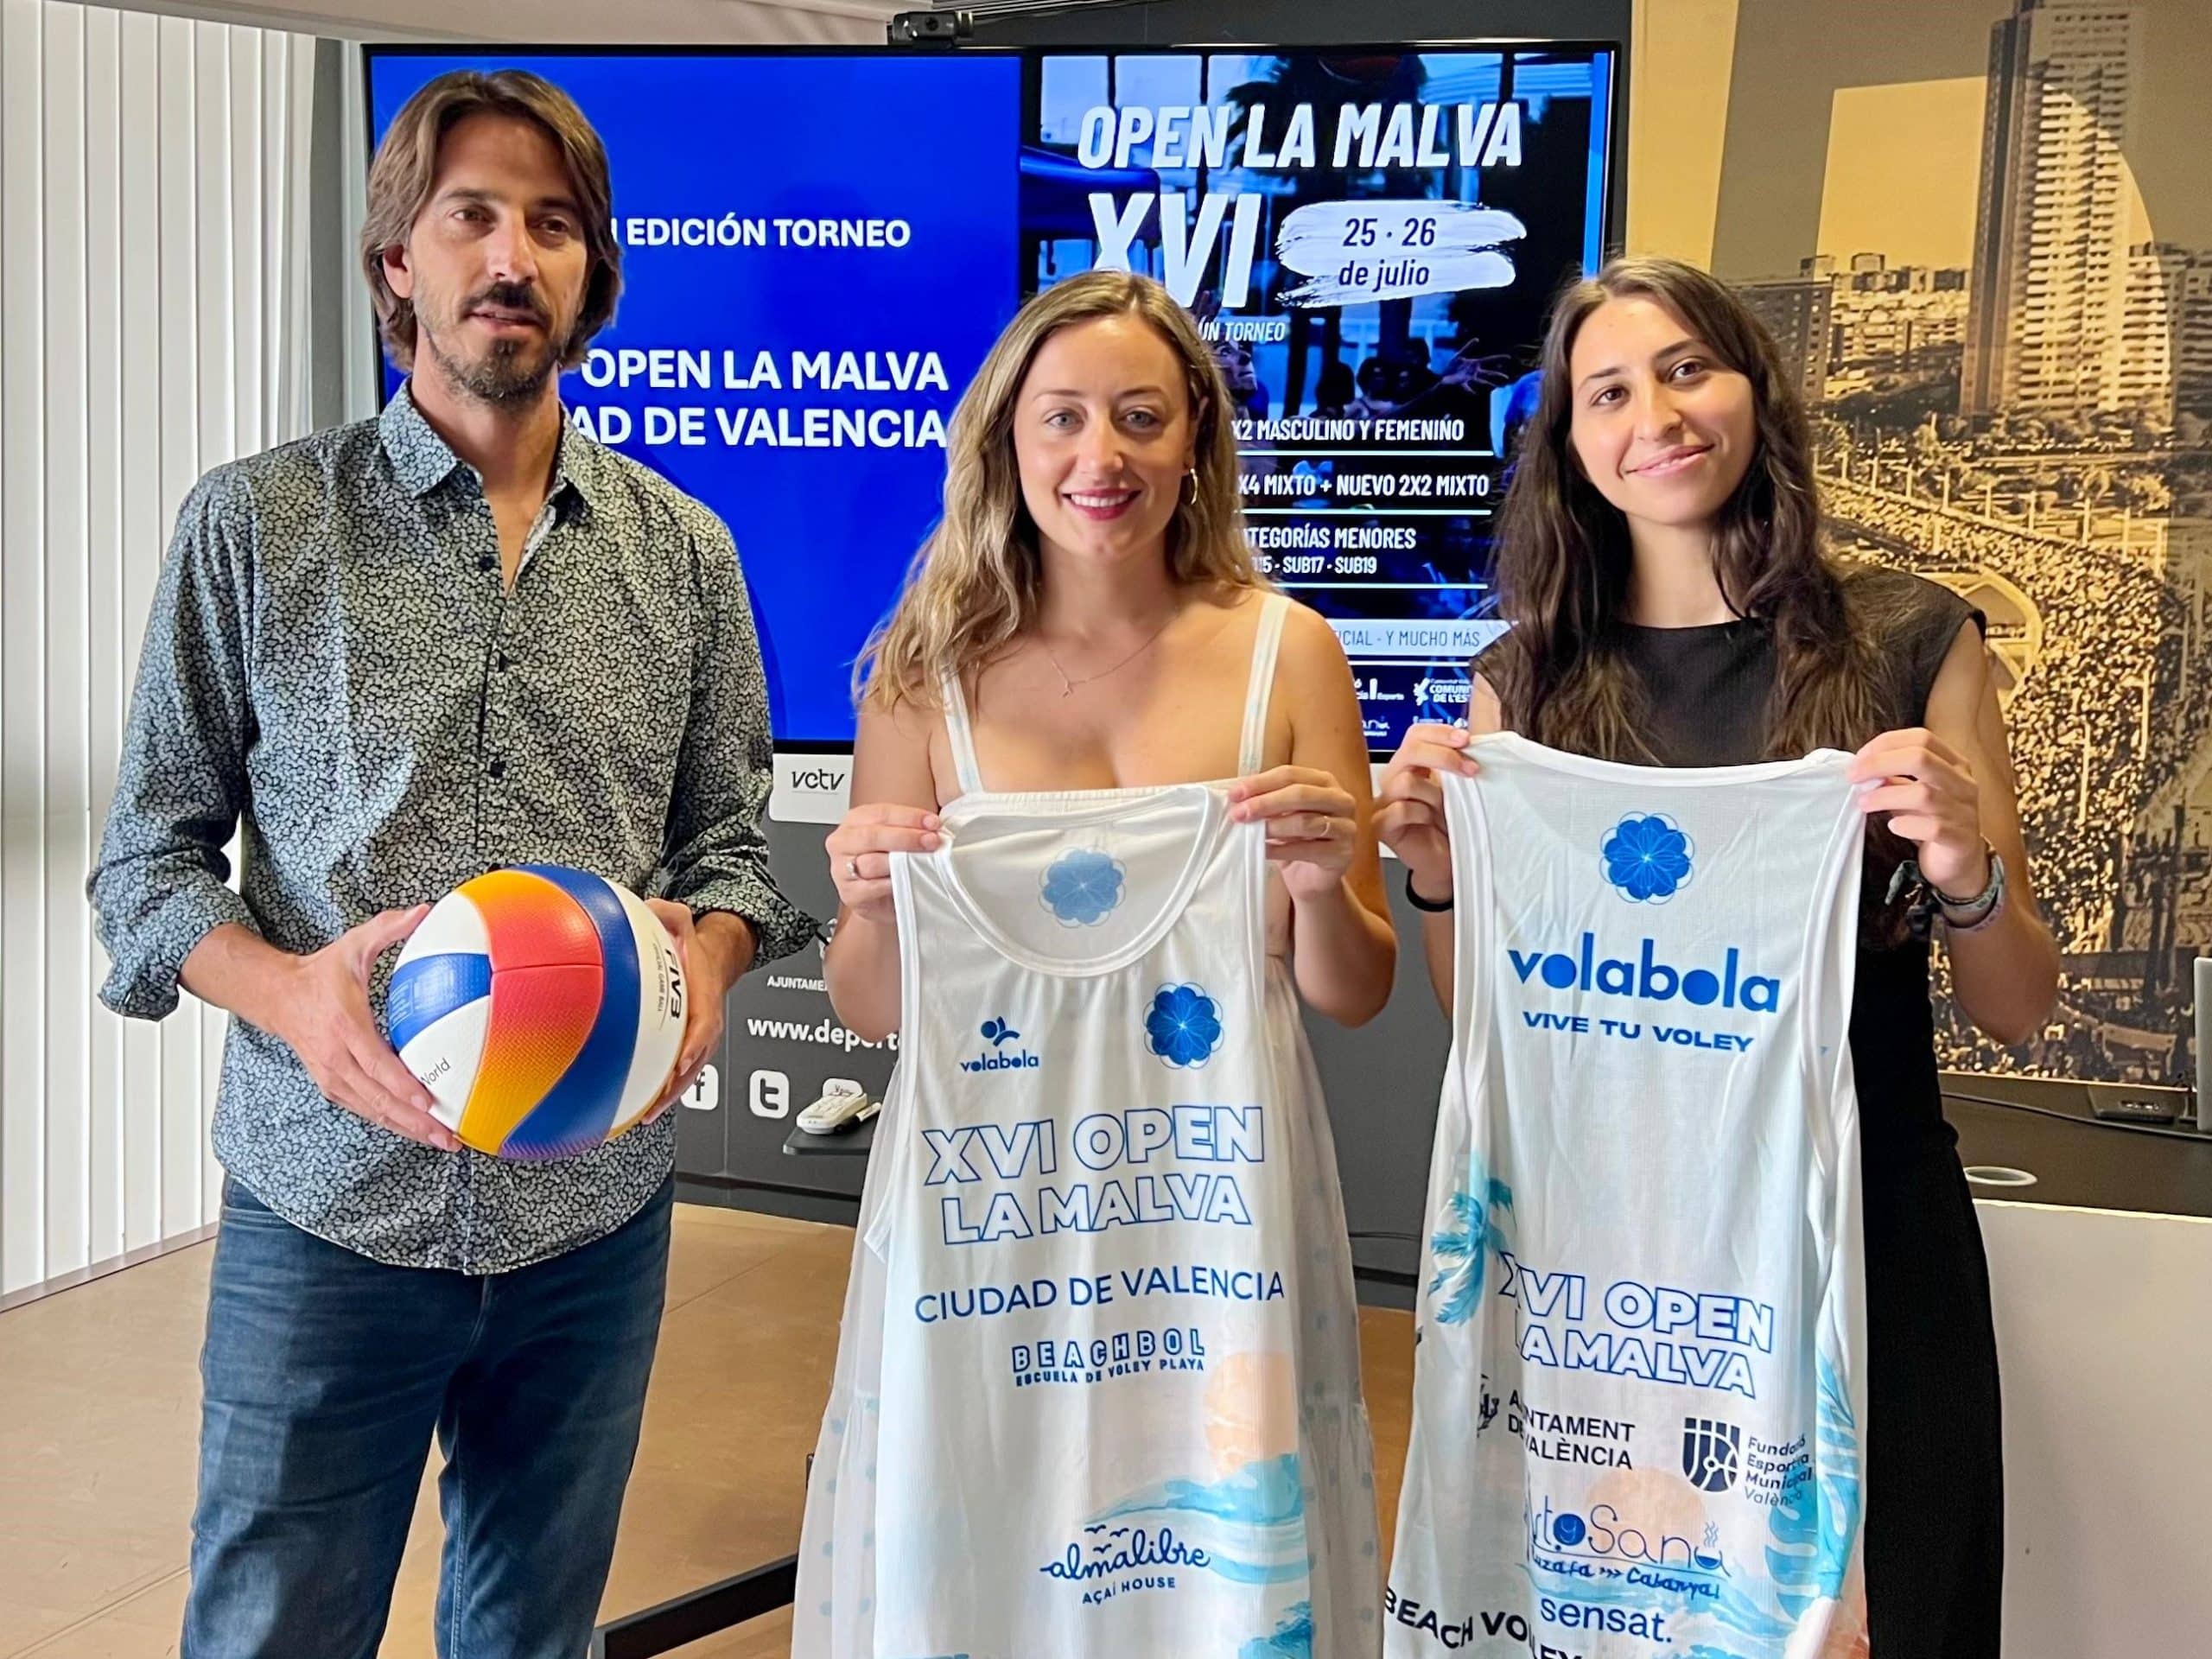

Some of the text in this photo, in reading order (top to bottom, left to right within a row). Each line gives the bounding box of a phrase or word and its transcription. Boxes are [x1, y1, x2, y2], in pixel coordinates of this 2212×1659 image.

[1077, 102, 1522, 168] OPEN LA MALVA
[626, 212, 766, 246] EDICIÓN
[772, 218, 911, 248] TORNEO
[1342, 217, 1376, 247] 25
[1402, 217, 1437, 247] 26
[1088, 192, 1262, 308] XVI
[1338, 258, 1430, 292] de julio
[1224, 321, 1287, 341] TORNEO
[582, 348, 949, 391] OPEN LA MALVA
[643, 407, 707, 446] DE
[714, 408, 948, 448] VALENCIA
[1256, 418, 1354, 441] MASCULINO
[1357, 419, 1370, 441] Y
[1263, 474, 1316, 496] MIXTO
[1336, 474, 1395, 497] NUEVO
[1398, 474, 1432, 496] 2X2
[1435, 474, 1490, 497] MIXTO
[1334, 526, 1417, 550] MENORES
[1282, 556, 1325, 574] SUB17
[1334, 556, 1377, 575] SUB19
[1386, 632, 1395, 646] Y
[1398, 632, 1447, 647] MUCHO
[791, 769, 845, 791] vctv
[767, 976, 829, 992] AJUNTAME
[1507, 931, 1781, 1014] volabola
[1522, 1011, 1754, 1052] VIVE TU VOLEY
[960, 1048, 1039, 1073] volabola
[922, 1105, 1265, 1186] XVI OPEN
[941, 1173, 1252, 1246] LA MALVA
[914, 1265, 1285, 1324] CIUDAD DE VALENCIA
[1604, 1281, 1774, 1354] OPEN
[1012, 1328, 1205, 1373] BEACHBOL
[1564, 1329, 1756, 1399] MALVA
[1015, 1357, 1205, 1388] ESCUELA DE VOLEY PLAYA
[1040, 1527, 1211, 1580] almalibre
[1082, 1576, 1176, 1605] AÇAÍ HOUSE
[1541, 1598, 1672, 1643] sensat.
